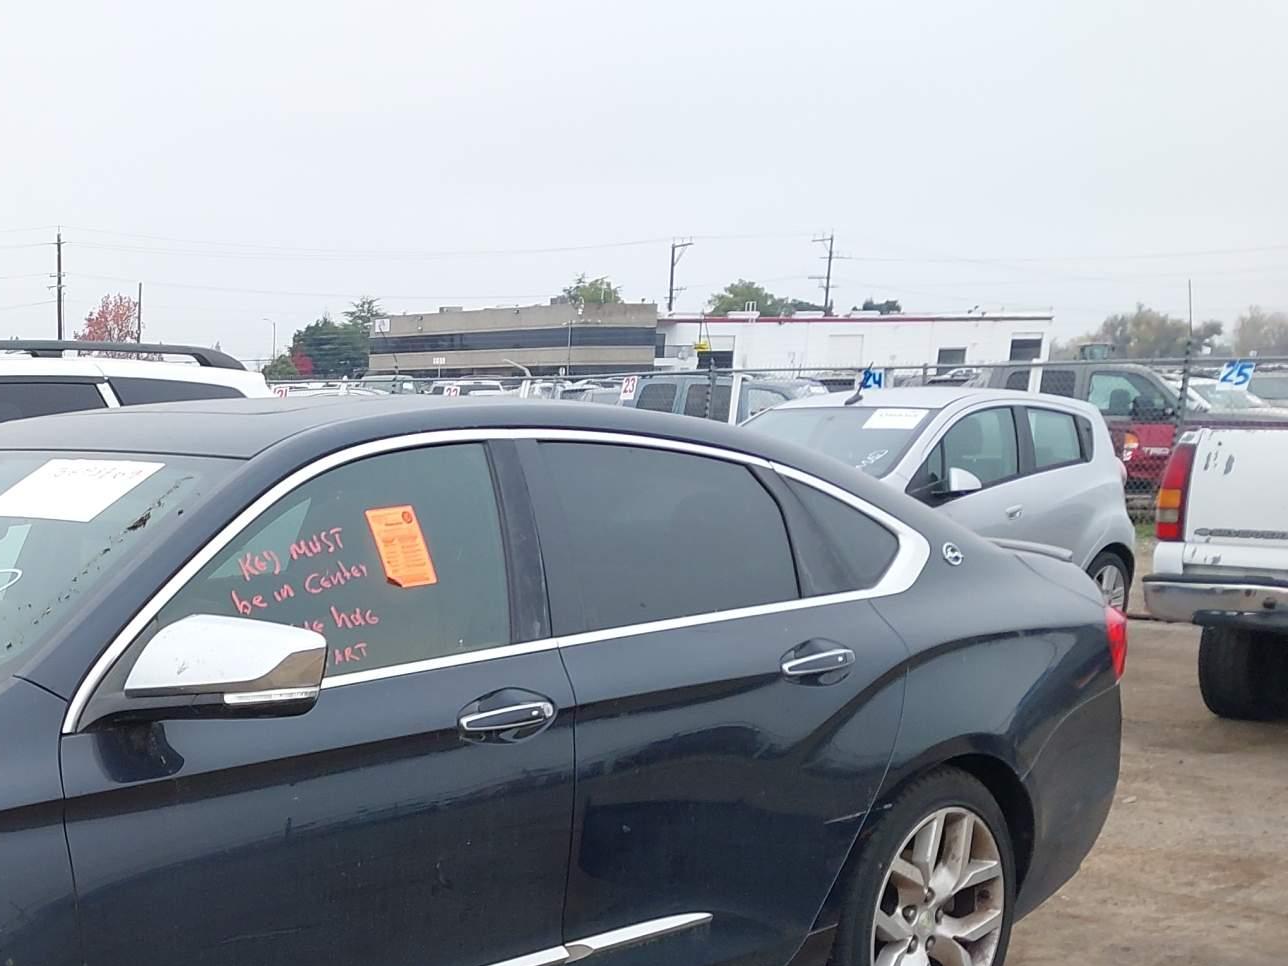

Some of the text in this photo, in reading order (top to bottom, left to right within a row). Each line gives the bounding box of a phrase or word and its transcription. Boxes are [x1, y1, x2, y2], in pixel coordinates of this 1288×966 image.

[862, 370, 882, 389] 24
[1221, 360, 1253, 386] 25
[622, 377, 636, 394] 23
[289, 527, 344, 560] MUST
[231, 560, 368, 615] be in Center
[334, 642, 368, 665] ART
